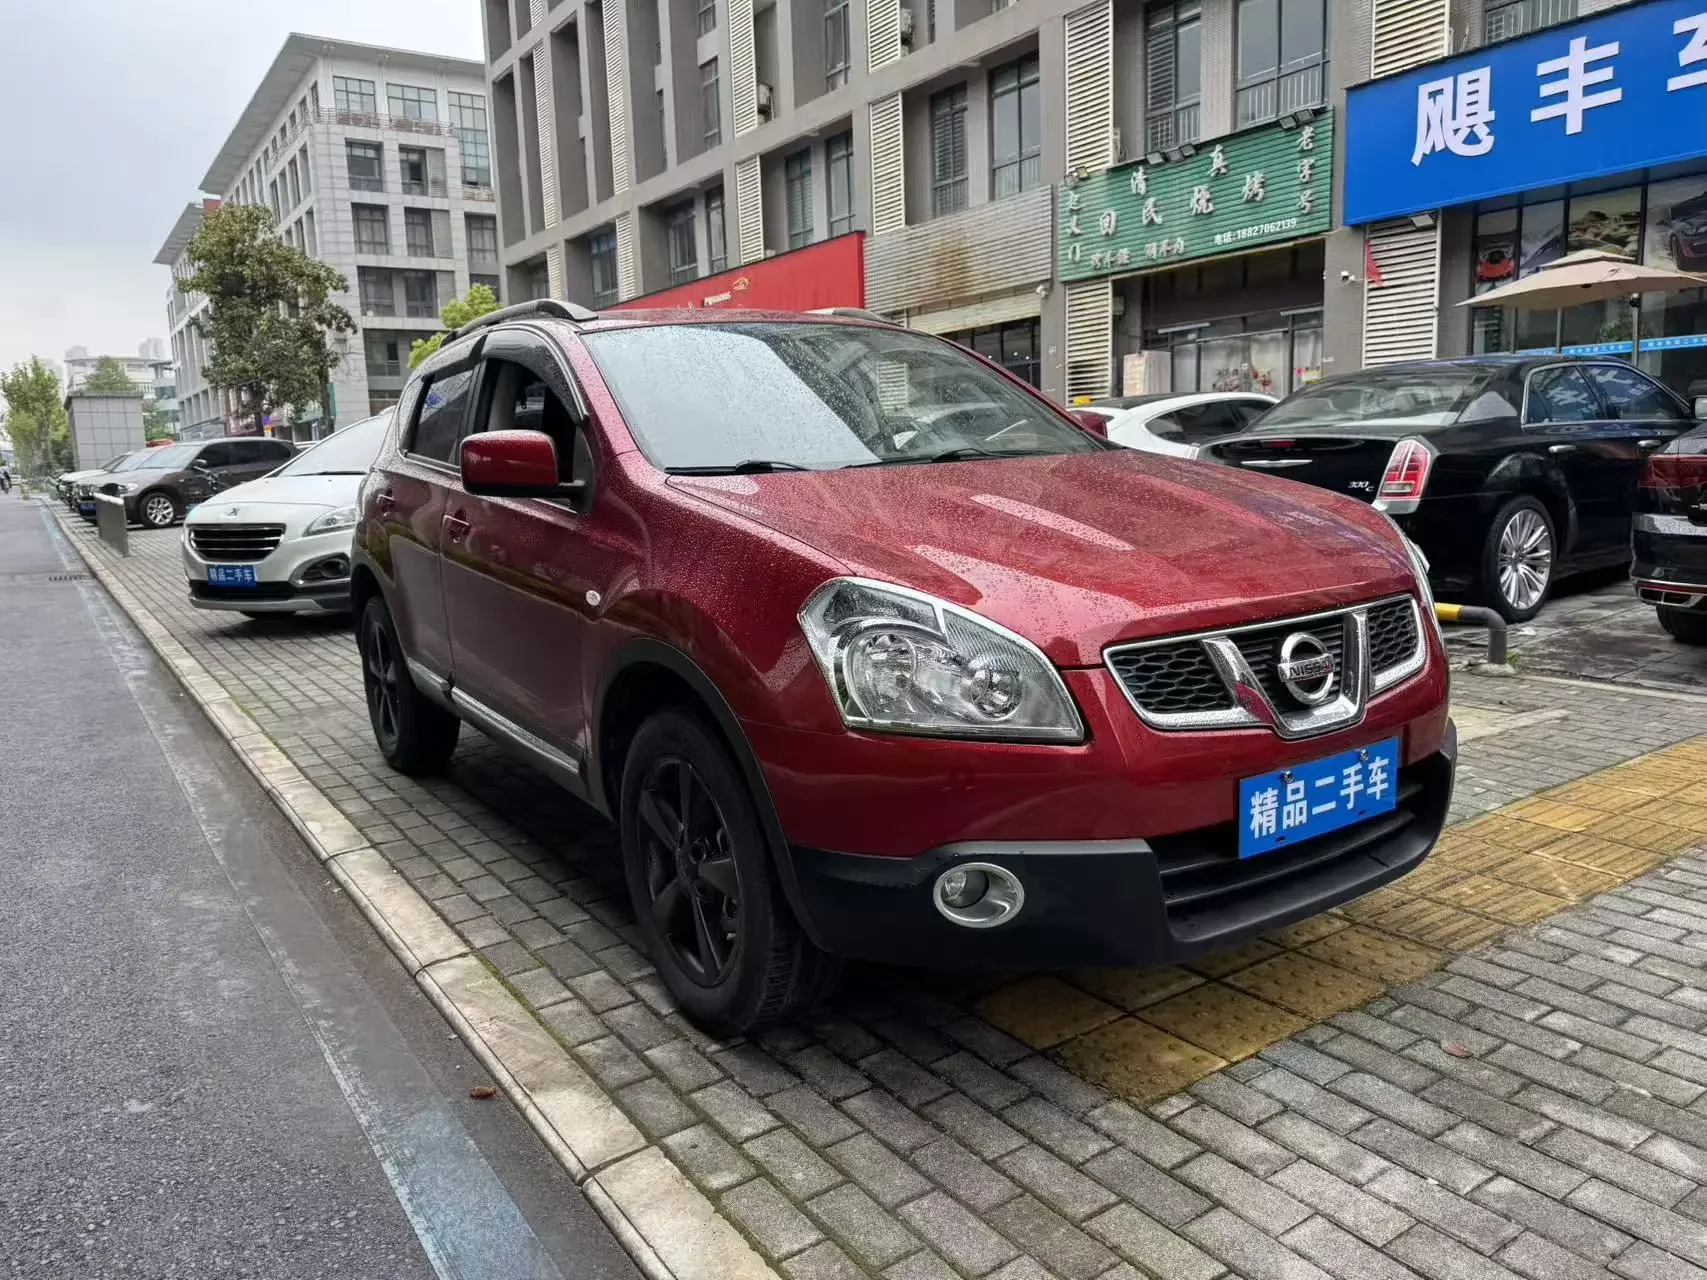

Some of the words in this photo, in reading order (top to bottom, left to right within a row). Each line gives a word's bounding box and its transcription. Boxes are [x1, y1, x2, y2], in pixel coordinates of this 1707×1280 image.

[1249, 756, 1390, 839] 精品二手车
